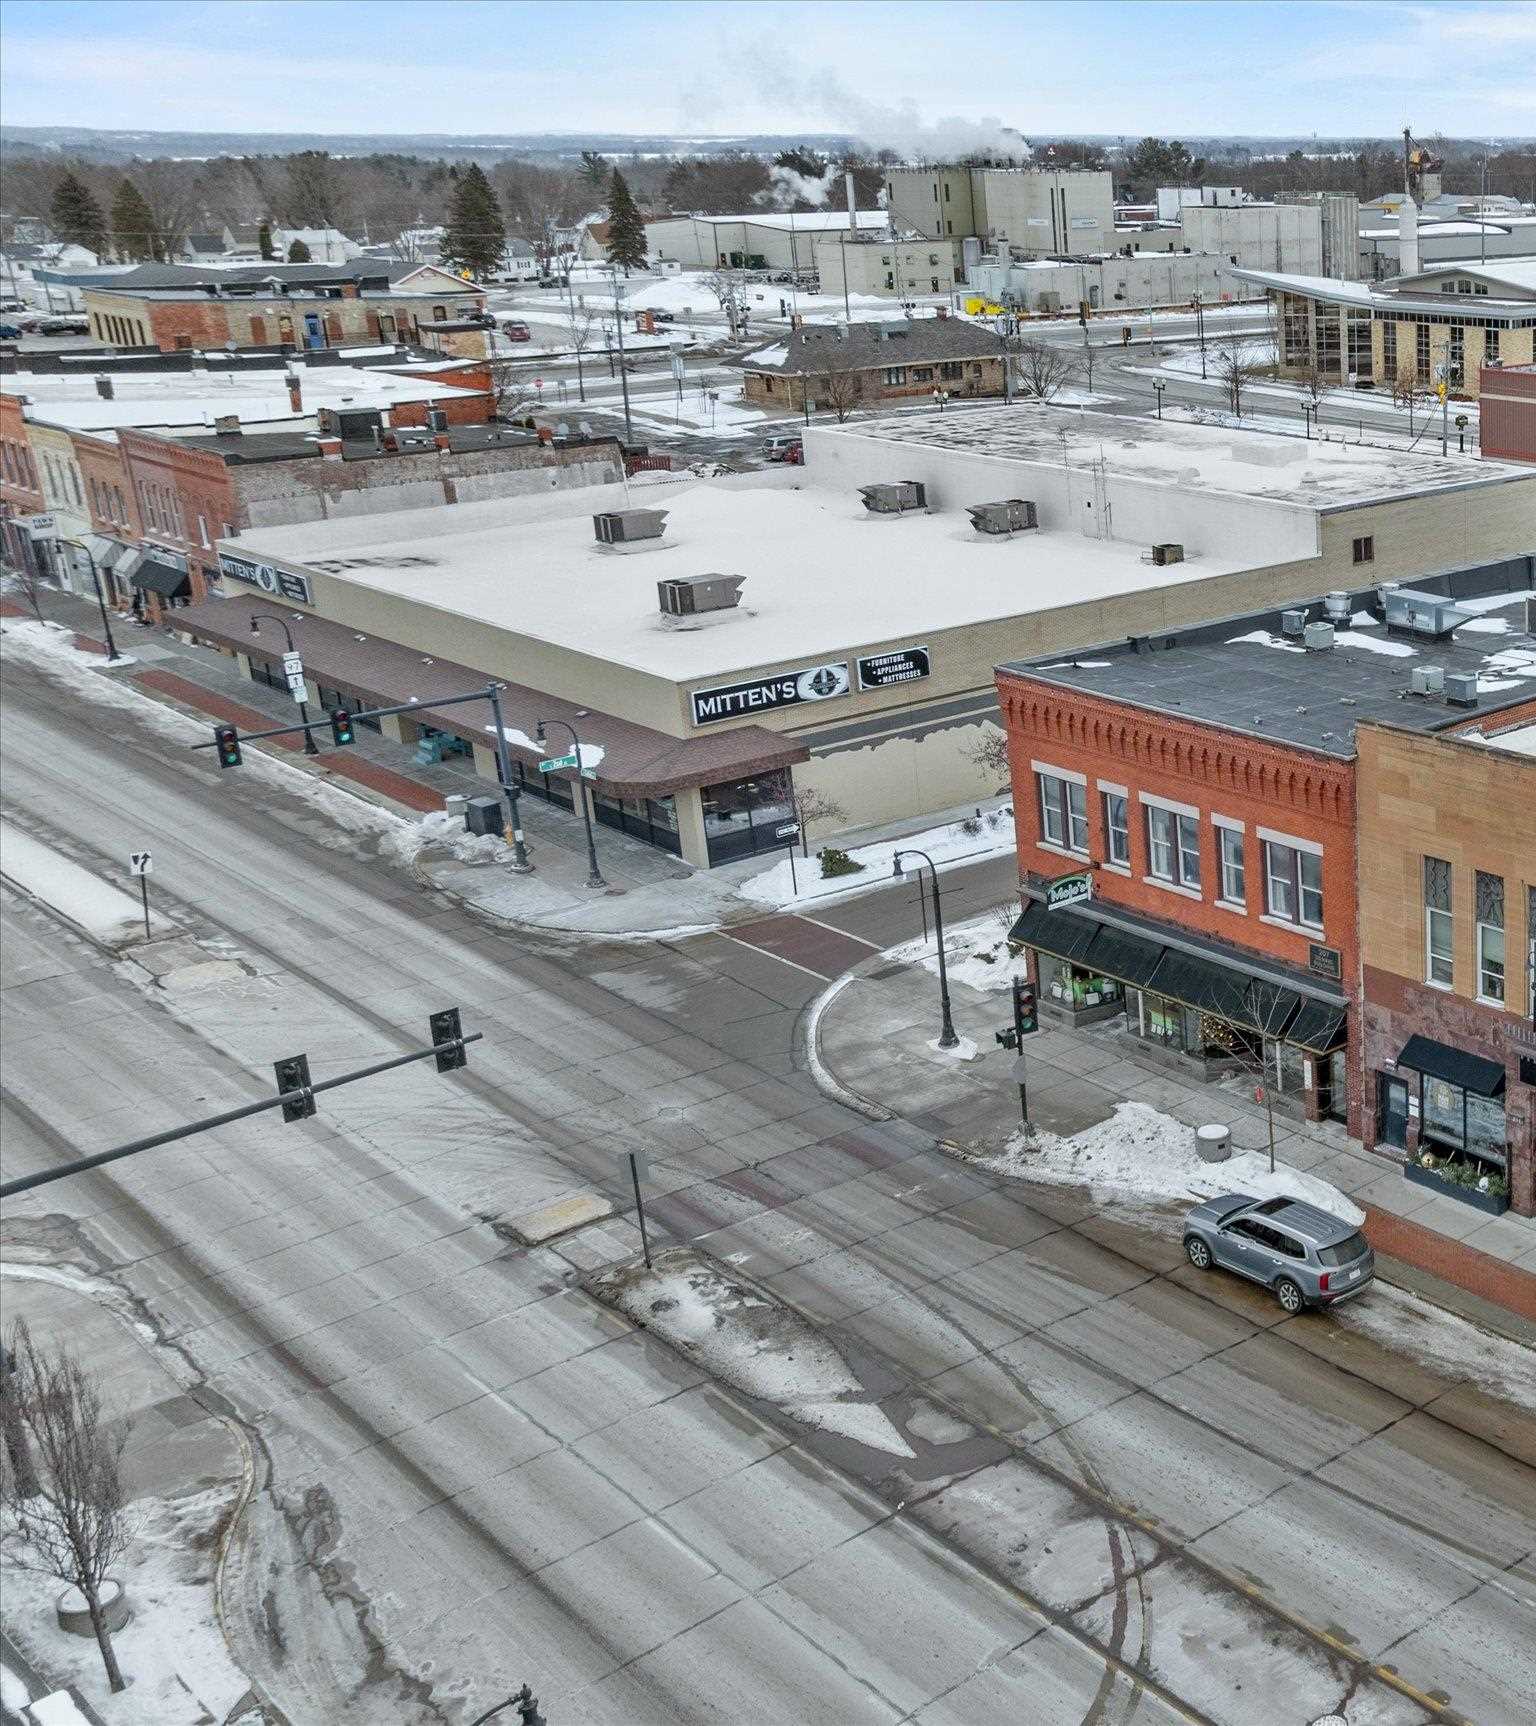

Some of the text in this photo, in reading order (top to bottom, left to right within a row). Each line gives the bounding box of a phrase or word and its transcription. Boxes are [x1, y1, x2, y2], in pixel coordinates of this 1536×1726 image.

[871, 654, 905, 668] FURNITURE
[877, 661, 914, 675] APPLIANCES
[882, 669, 921, 684] MATTRESSES
[698, 681, 796, 717] MITTEN'S
